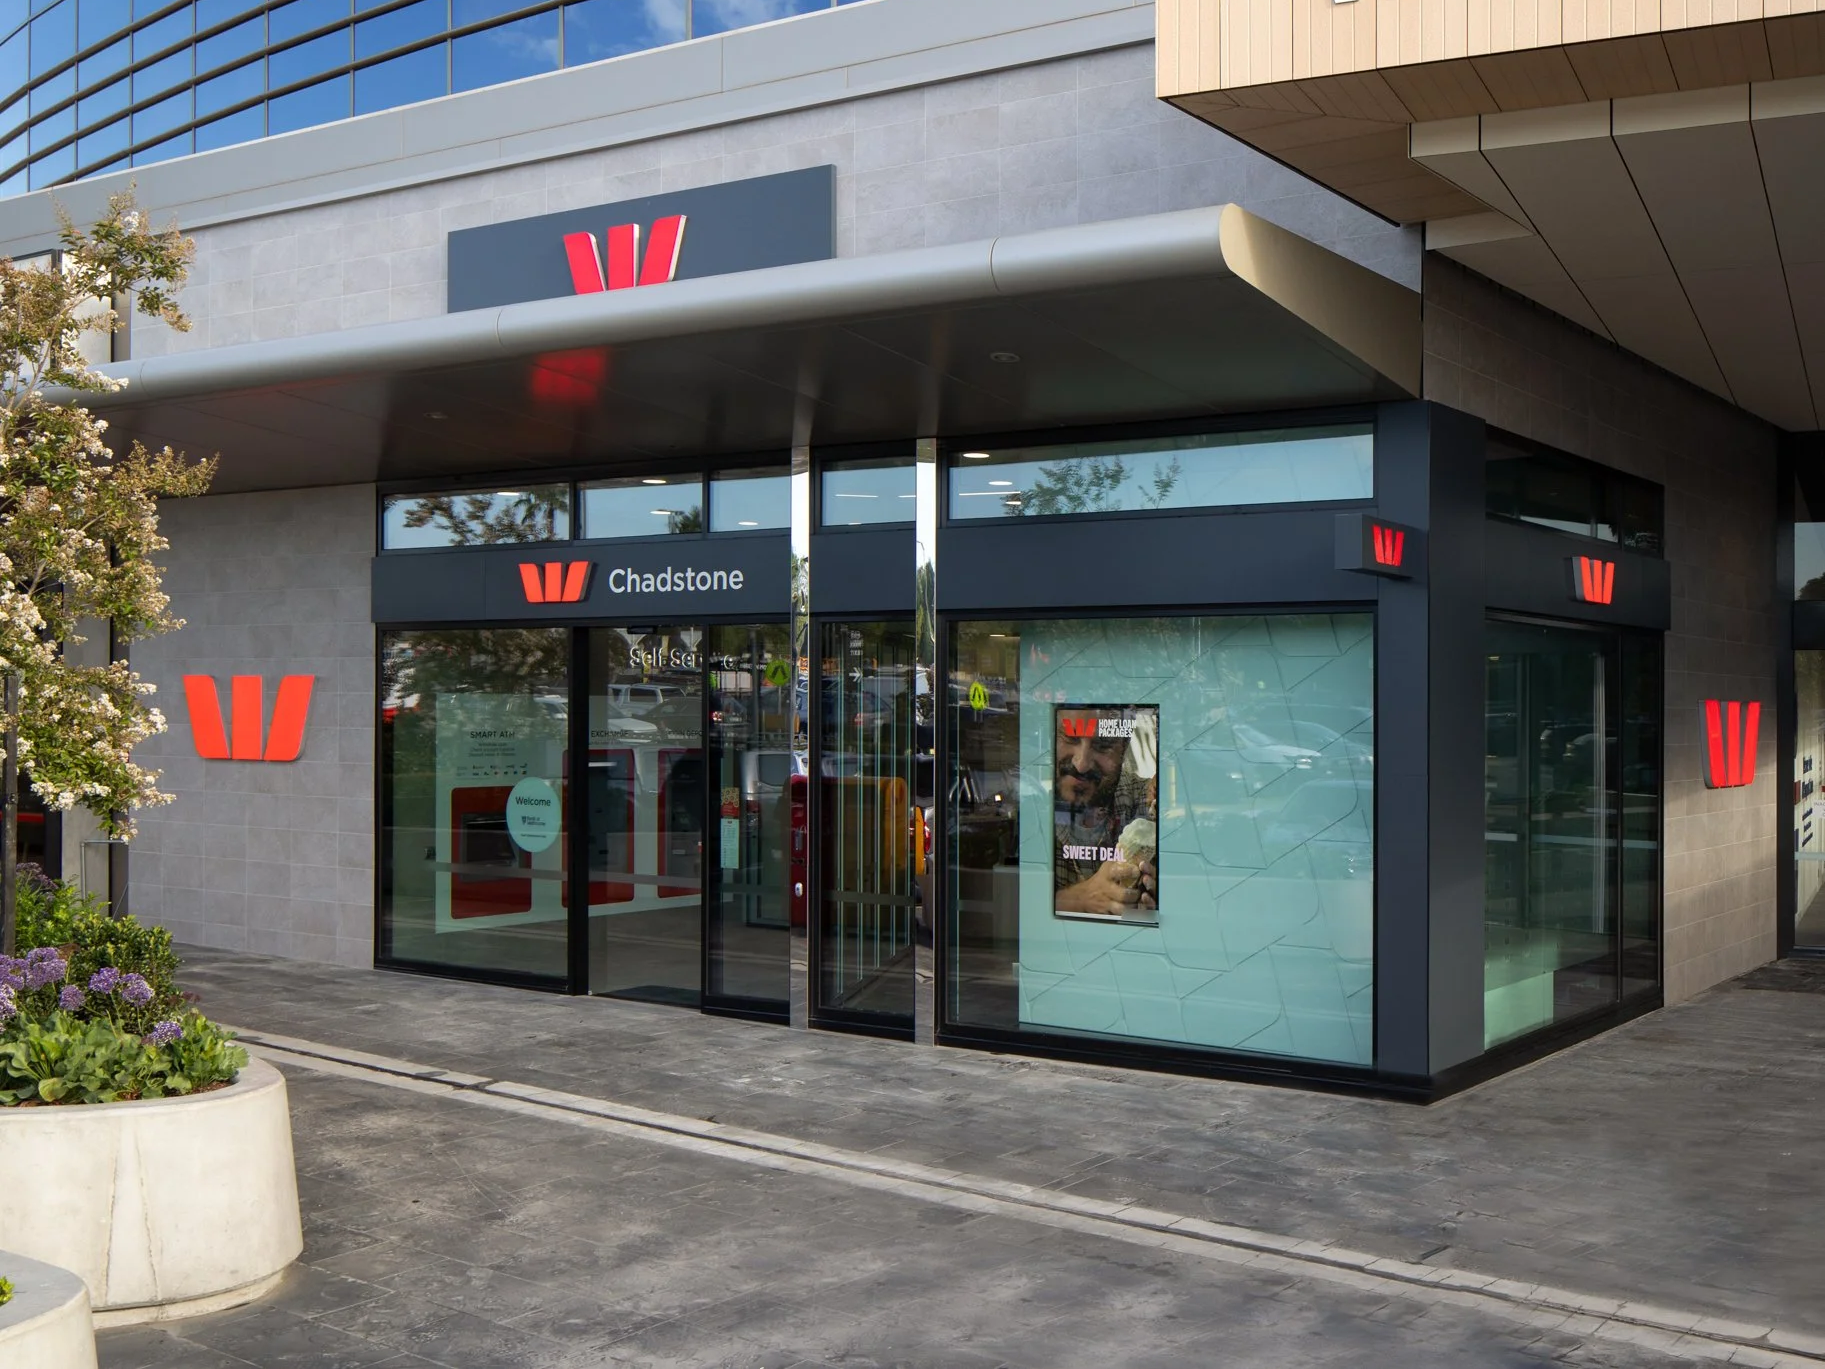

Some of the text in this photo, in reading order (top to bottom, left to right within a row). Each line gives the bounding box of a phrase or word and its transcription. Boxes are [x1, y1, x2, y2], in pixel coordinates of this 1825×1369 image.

[608, 567, 744, 593] Chadstone
[1098, 719, 1118, 728] HOME
[1119, 719, 1137, 729] LOAN
[470, 731, 497, 739] SMART
[1098, 728, 1133, 738] PACKAGES
[515, 796, 551, 806] Welcome
[1062, 844, 1126, 862] SWEET DEAL
